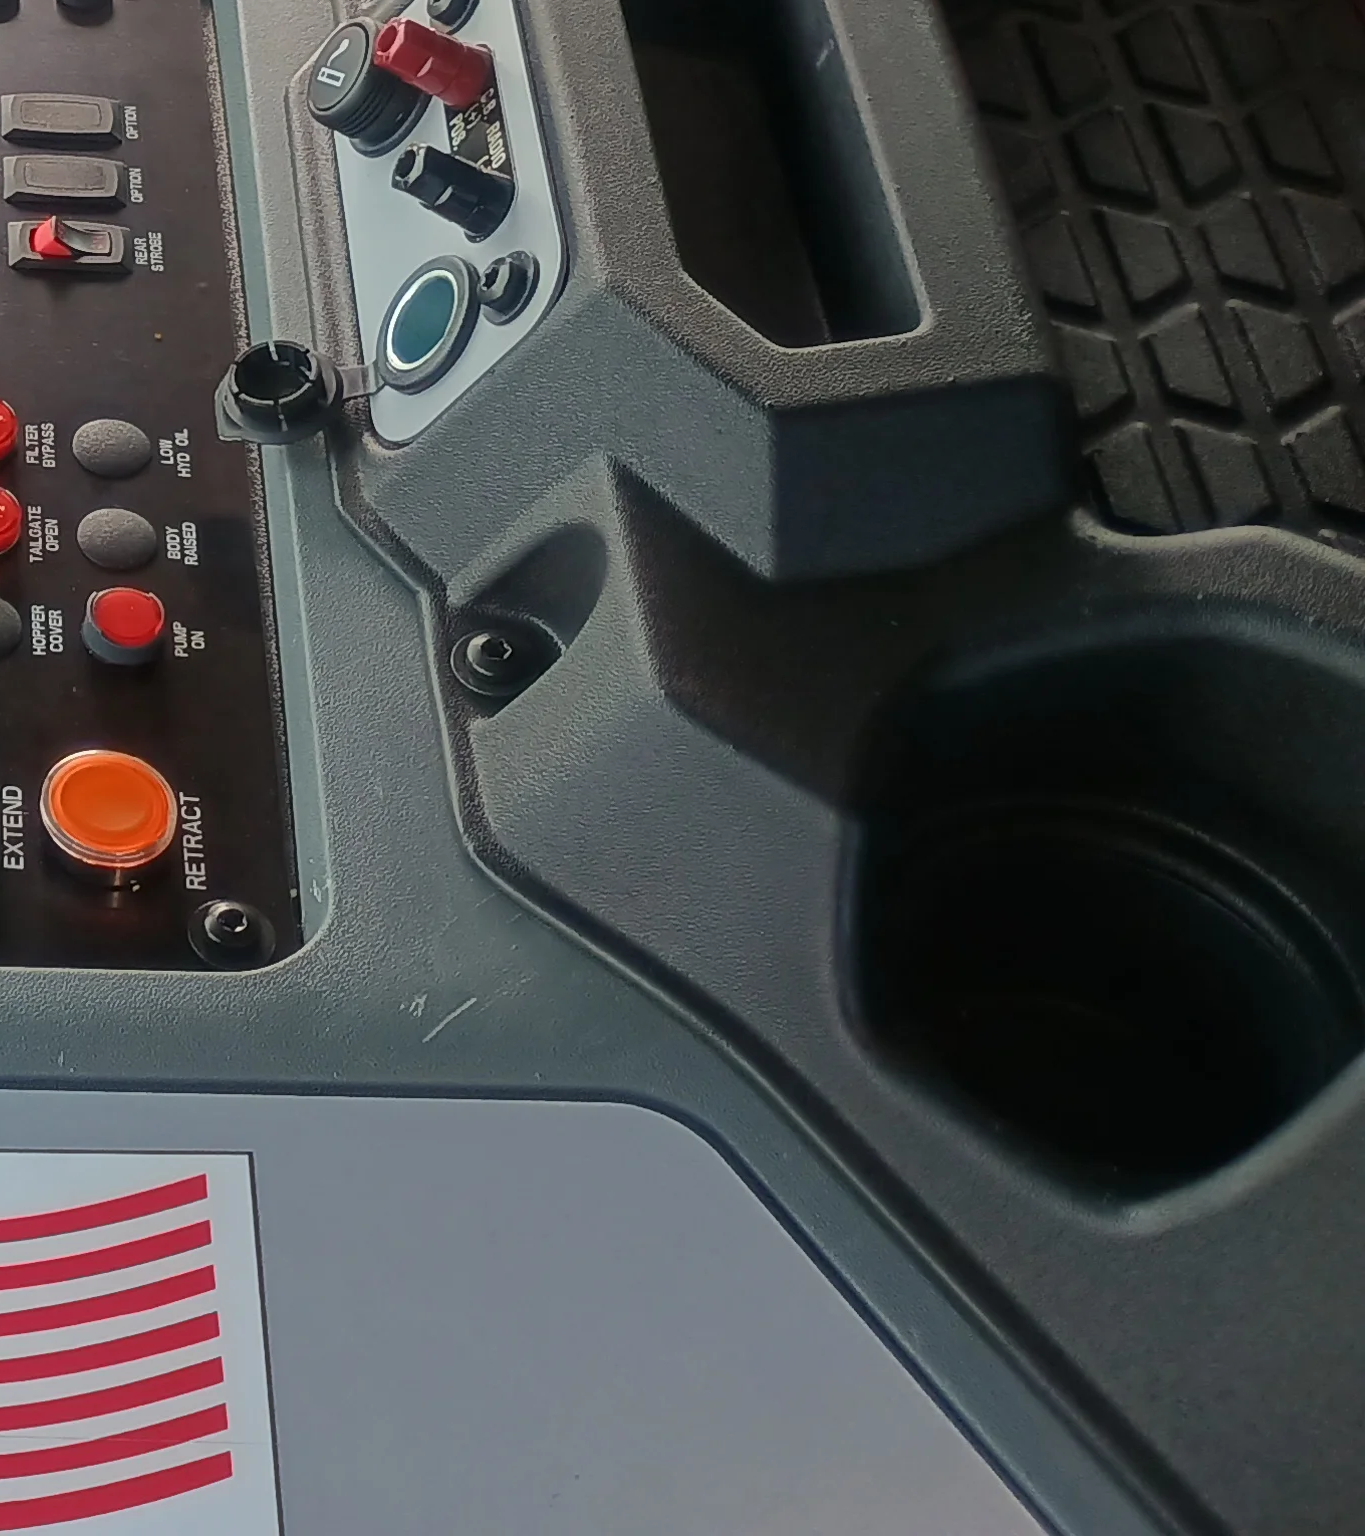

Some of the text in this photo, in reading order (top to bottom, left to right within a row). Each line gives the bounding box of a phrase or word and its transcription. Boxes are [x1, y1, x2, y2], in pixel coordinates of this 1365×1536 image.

[125, 104, 139, 140] OPTION
[485, 120, 507, 170] RADIO
[128, 166, 143, 203] OPTION
[135, 236, 150, 266] REAR
[150, 231, 166, 273] STROBE
[25, 424, 39, 465] FILTER
[41, 422, 56, 468] BYPASS
[160, 438, 174, 465] LOW
[177, 450, 192, 478] HYD
[27, 505, 43, 563] TAILGATE
[44, 517, 60, 553] OPEN
[166, 526, 181, 560] BODY
[183, 521, 199, 566] RAISED
[31, 604, 47, 656] HOPPER
[49, 610, 64, 654] COVER
[172, 621, 189, 658] PUMP
[191, 630, 206, 651] ON
[2, 784, 25, 872] EXTEND
[179, 791, 208, 892] RETRACT
